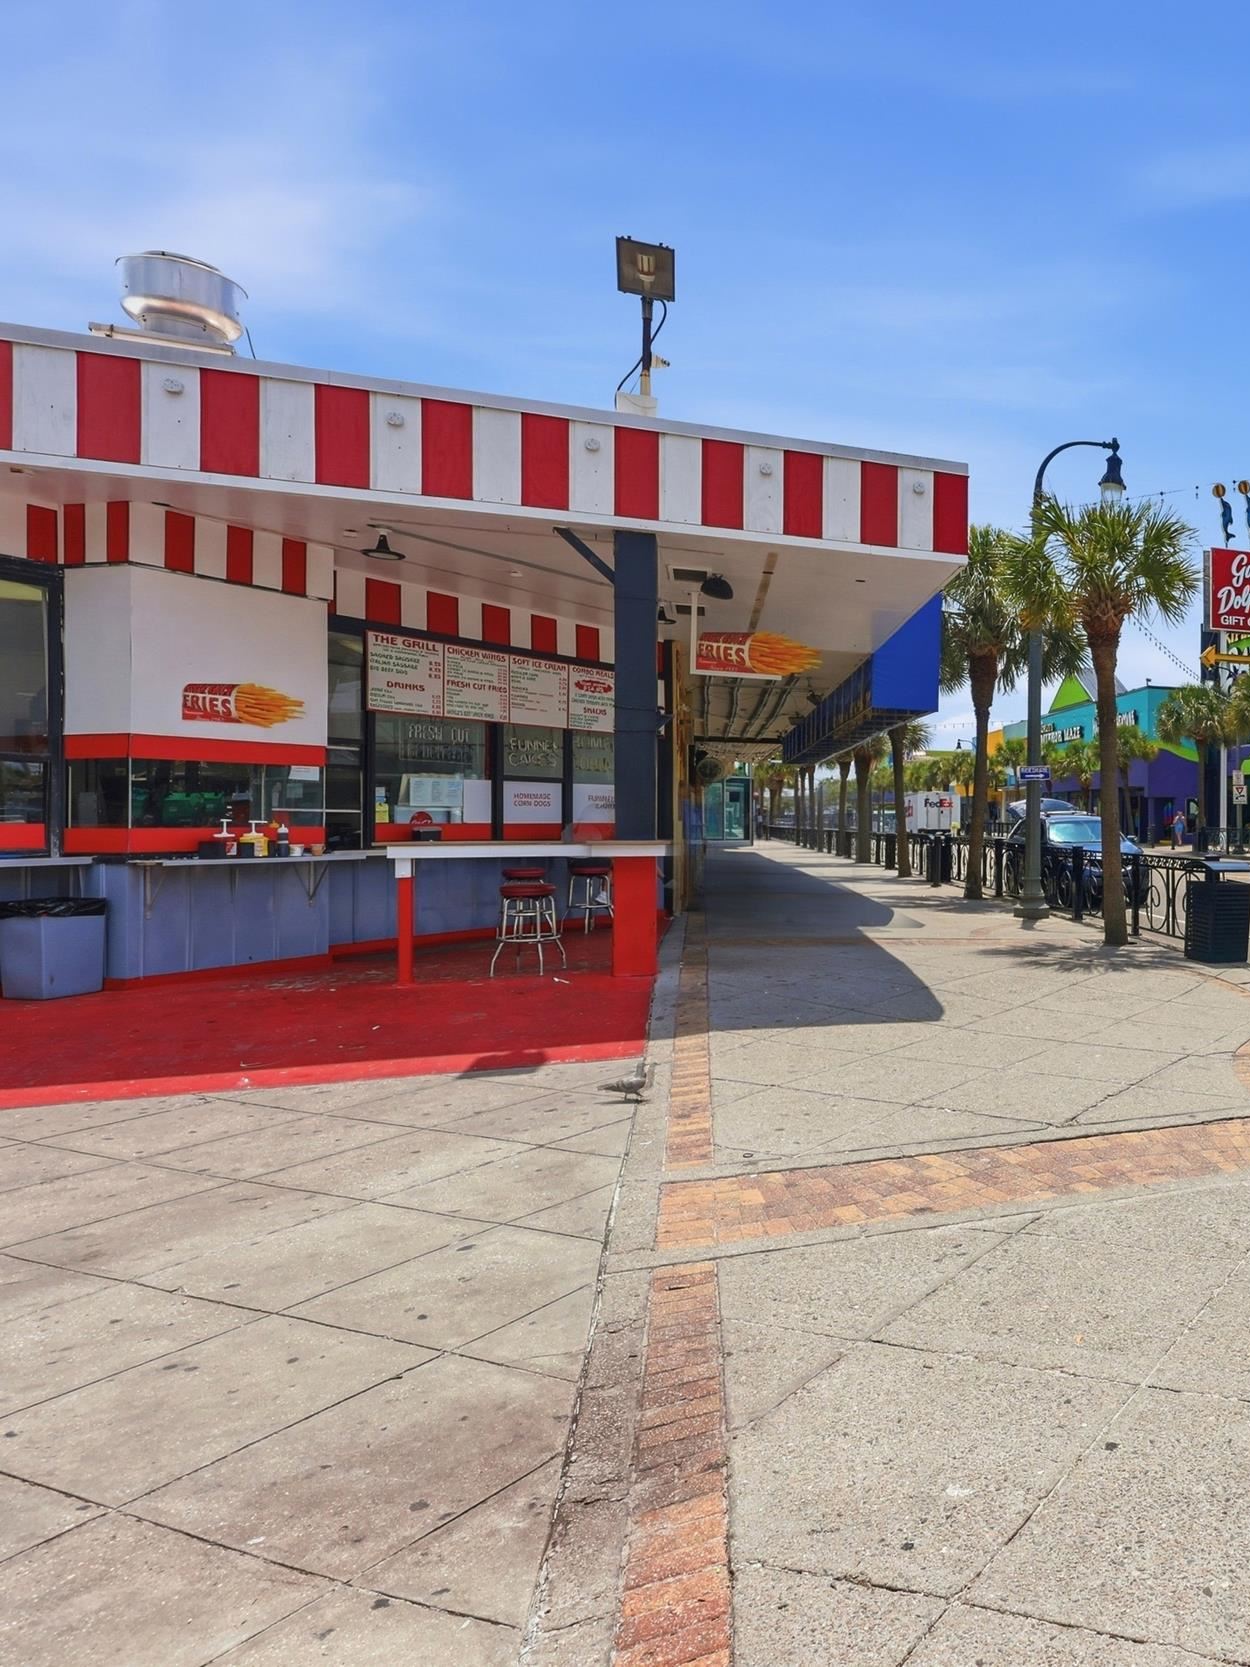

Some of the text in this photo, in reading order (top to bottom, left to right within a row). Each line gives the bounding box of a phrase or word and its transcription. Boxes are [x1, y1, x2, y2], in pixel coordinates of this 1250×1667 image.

[1220, 615, 1245, 627] GIFT
[373, 634, 398, 646] THE
[402, 639, 439, 652] GRILL
[447, 646, 479, 658] CHICKEN
[482, 652, 506, 662] WINGS
[698, 643, 746, 667] FRIES
[512, 658, 529, 666] SOFT
[532, 660, 541, 668] ICE
[544, 662, 566, 672] CREAM
[572, 667, 594, 676] COMBO
[596, 670, 614, 679] MEALS
[386, 681, 425, 692] DRINKS
[447, 680, 507, 694] FRESH CUT FRIES
[183, 694, 232, 718] FRIES
[409, 723, 470, 745] FRESH CUT
[1063, 726, 1081, 741] MAZE
[924, 798, 953, 808] FedEx
